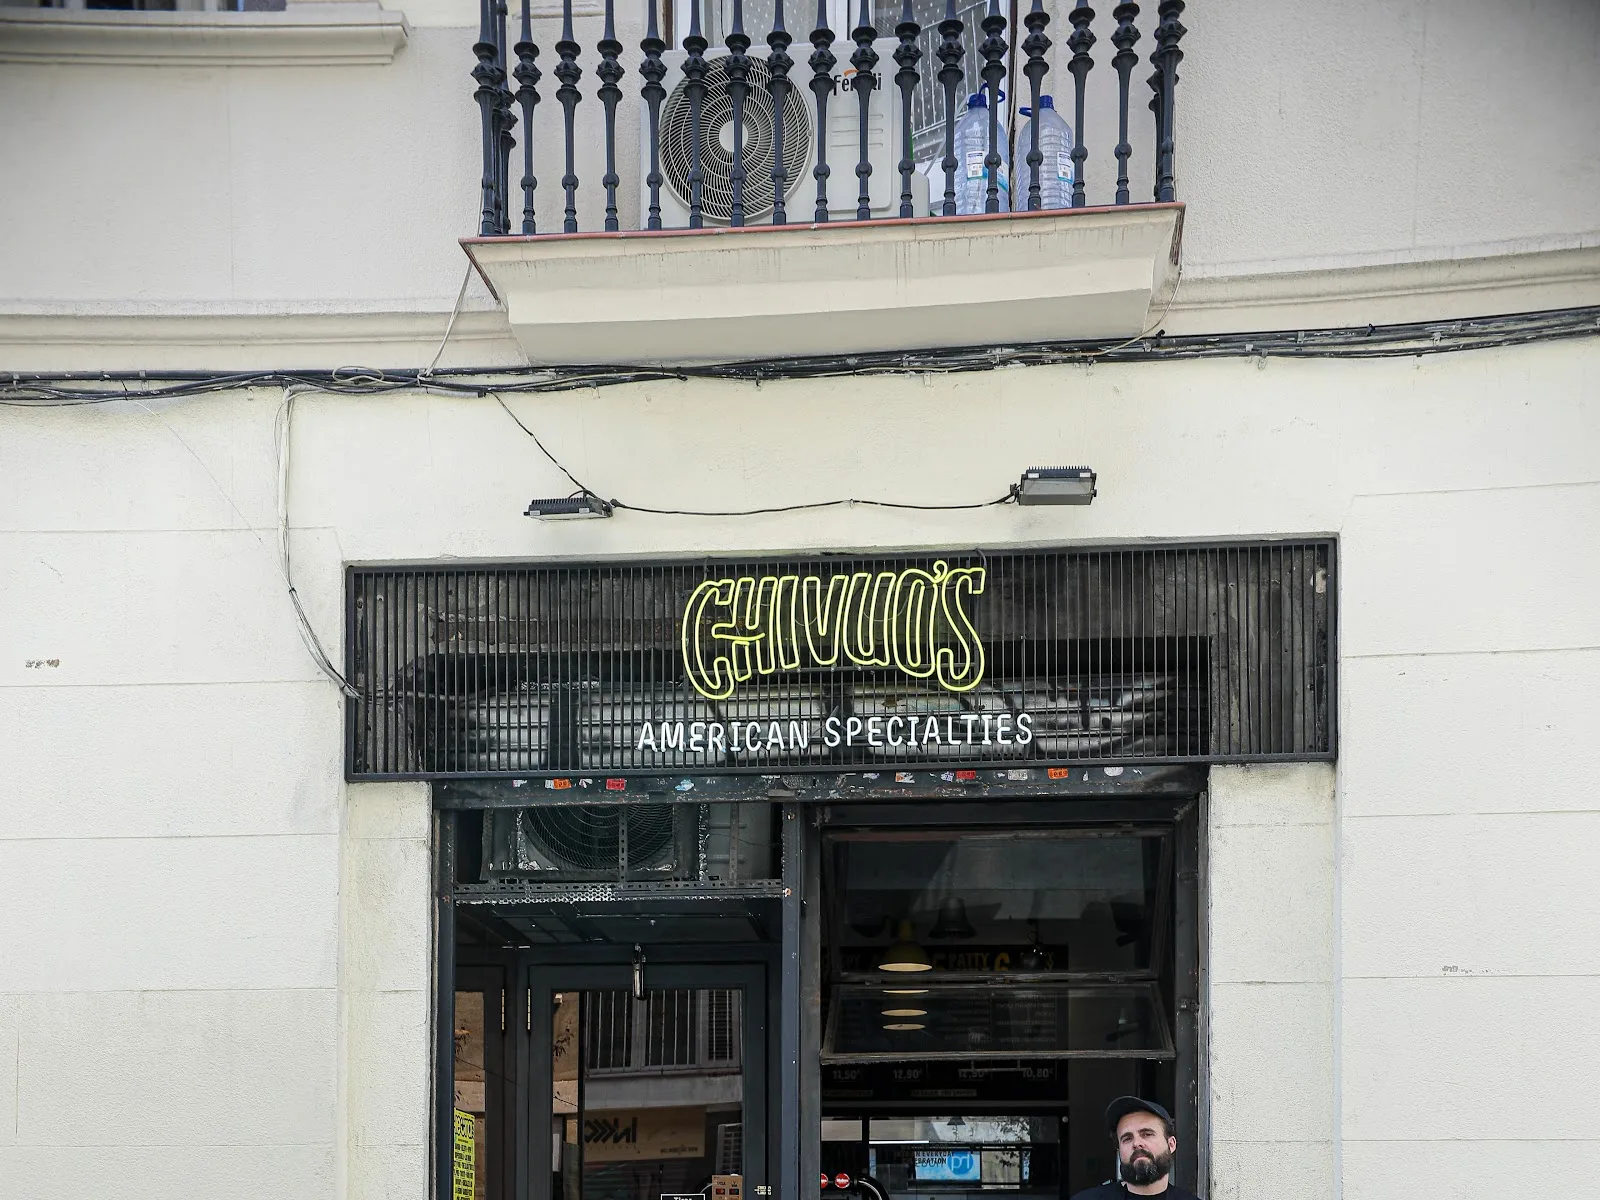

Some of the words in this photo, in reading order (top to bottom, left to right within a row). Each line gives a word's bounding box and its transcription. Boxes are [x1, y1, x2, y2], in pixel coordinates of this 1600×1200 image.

[682, 560, 986, 700] CHIVUO'S
[637, 718, 809, 752] AMERICAN
[824, 713, 1033, 748] SPECIALTIES
